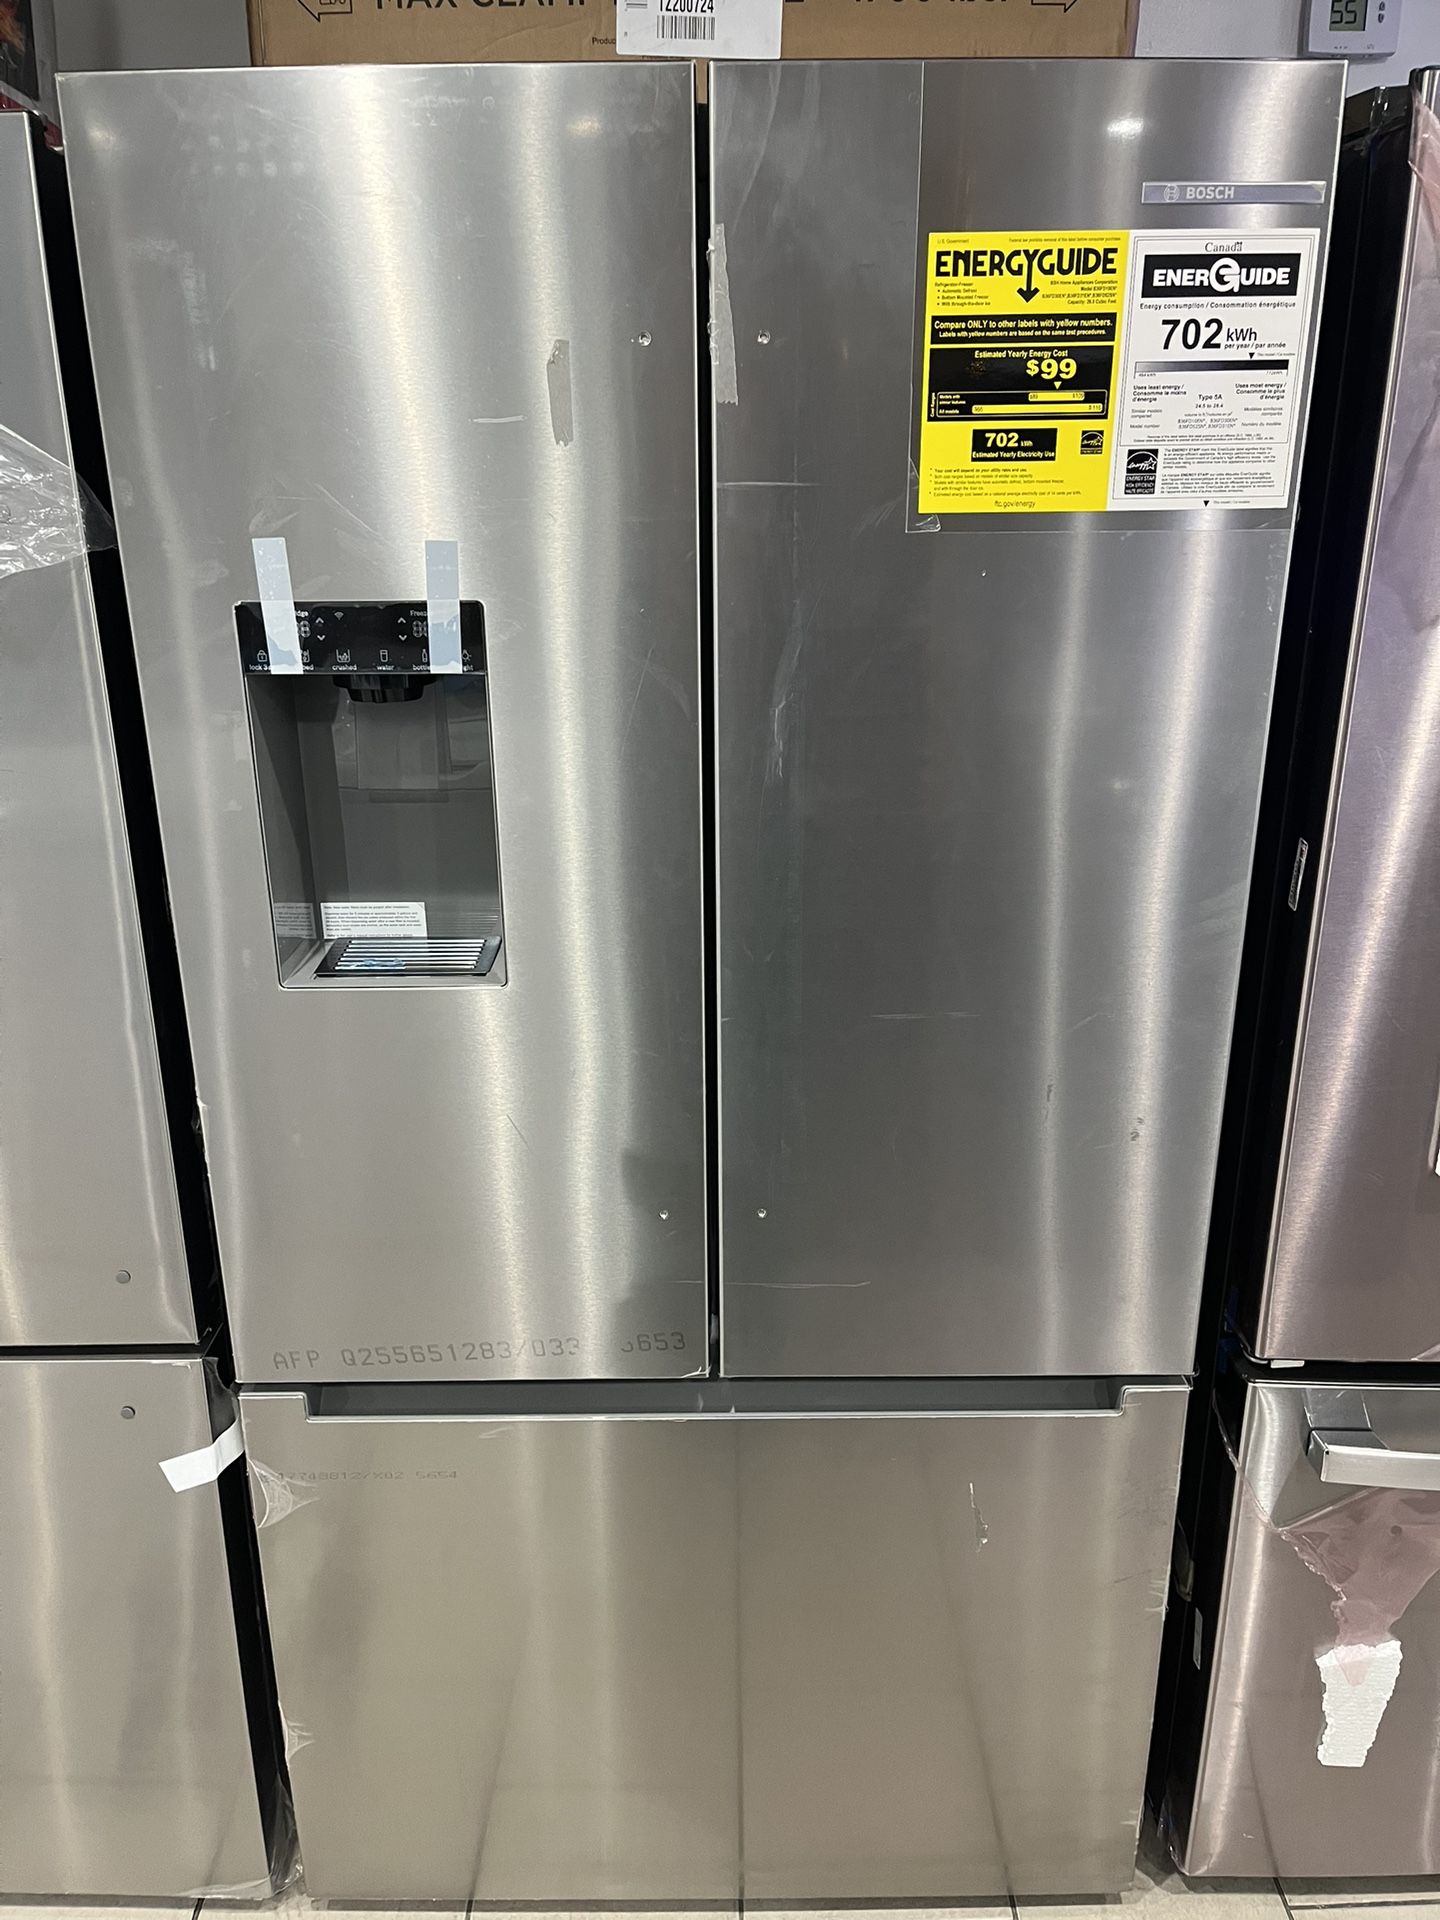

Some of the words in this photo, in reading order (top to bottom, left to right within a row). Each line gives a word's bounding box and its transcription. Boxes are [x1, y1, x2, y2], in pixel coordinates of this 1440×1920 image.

[1185, 186, 1235, 200] BOSCH
[1204, 241, 1243, 253] Canada
[936, 248, 1119, 281] ENERGYGUIDE
[1152, 257, 1291, 293] ENERGUIDE
[1139, 302, 1162, 311] Energy
[1163, 302, 1204, 311] consumption
[1209, 301, 1257, 309] Consommation
[1258, 301, 1296, 310] énergétique
[934, 320, 966, 331] Compare
[967, 320, 988, 329] ONLY
[989, 320, 997, 328] to
[998, 320, 1017, 328] other
[1017, 319, 1038, 328] labels
[1040, 319, 1055, 327] with
[1056, 318, 1079, 329] yellow
[1080, 318, 1113, 327] numbers.
[968, 331, 985, 339] yellow
[1161, 318, 1223, 350] 702
[1226, 327, 1257, 342] kWh
[1256, 342, 1266, 350] par
[1267, 341, 1286, 349] année
[974, 350, 1006, 359] Estimated
[1007, 349, 1027, 360] Yearly
[1029, 350, 1051, 360] Energy
[1052, 349, 1069, 358] Cost
[1025, 358, 1077, 380] $99
[985, 432, 1019, 448] 702
[972, 451, 998, 459] Estimated
[1000, 451, 1016, 460] Yearly
[1017, 450, 1043, 460] Electricity
[1045, 450, 1055, 458] Use
[273, 1350, 319, 1369] AFP
